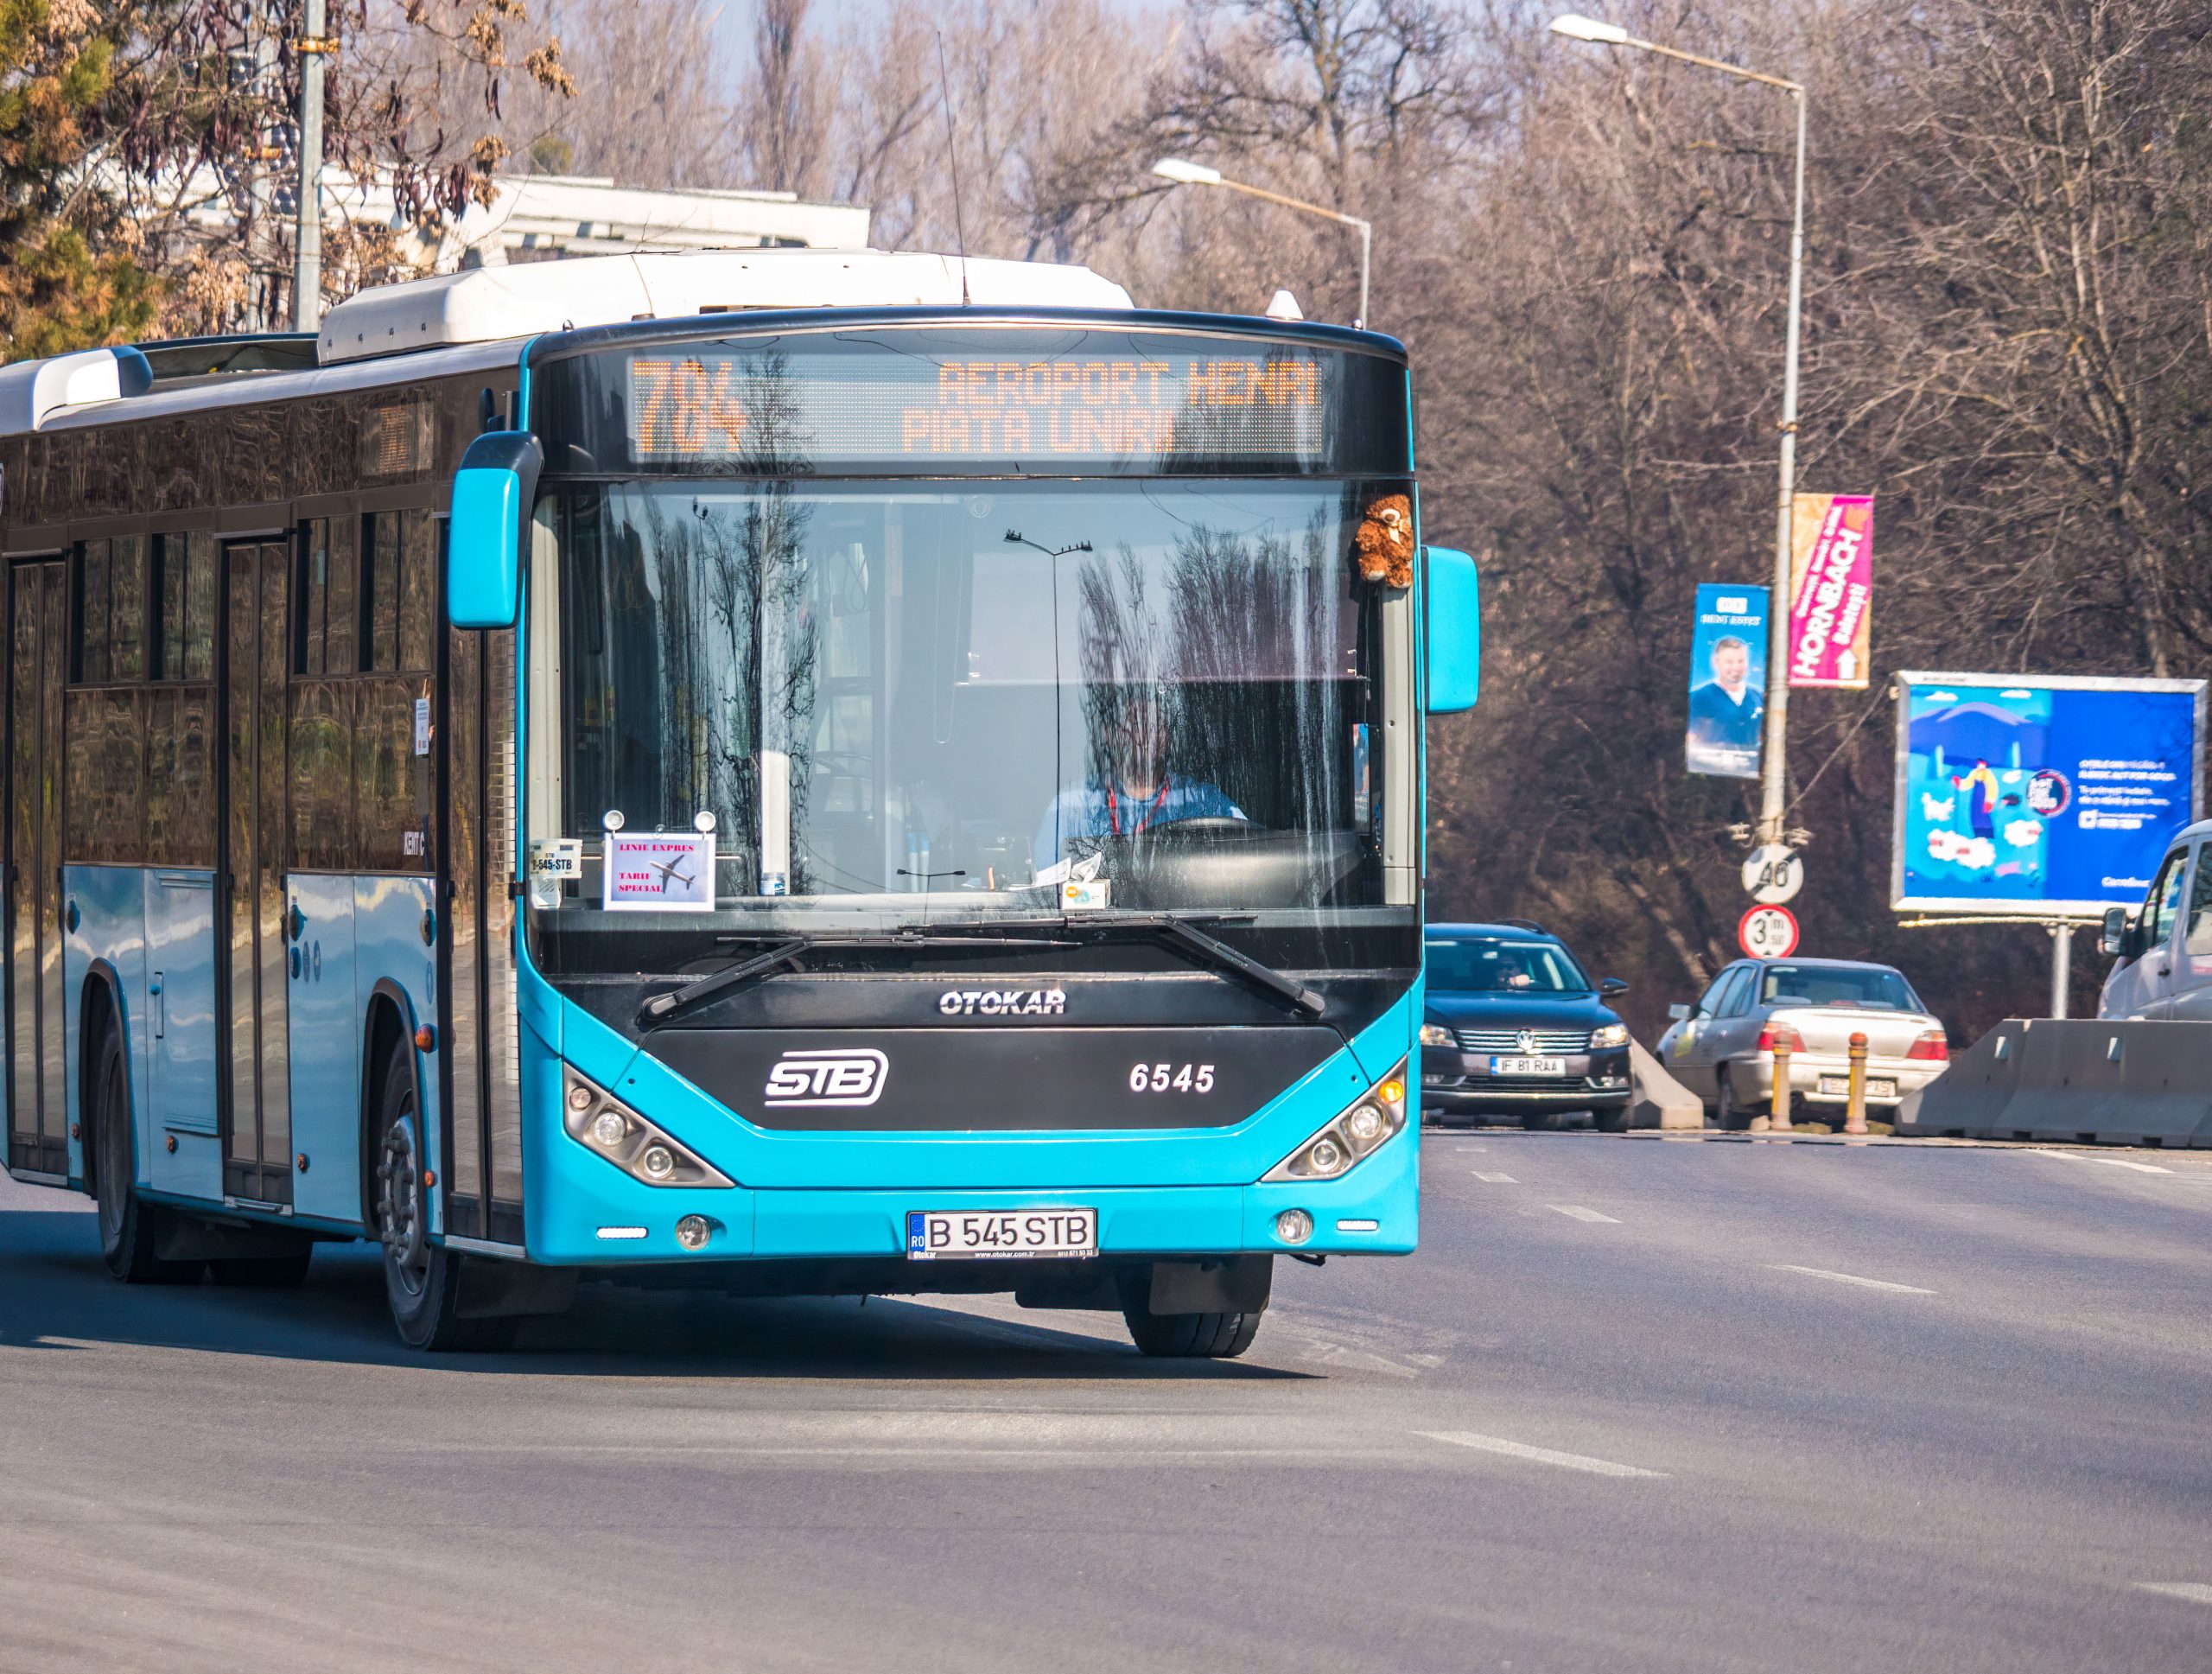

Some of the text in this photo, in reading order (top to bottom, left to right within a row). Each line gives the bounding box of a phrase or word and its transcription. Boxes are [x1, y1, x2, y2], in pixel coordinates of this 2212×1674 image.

[939, 361, 1316, 405] AEROPORT HENRI
[903, 408, 1173, 453] PIATA UNIRII
[1791, 527, 1864, 678] HORNBACH
[619, 843, 695, 853] LINIE EXPRES
[619, 871, 652, 881] TARIF
[1758, 861, 1789, 888] 40
[619, 884, 664, 893] SPECIAL
[1752, 918, 1767, 945] 3
[938, 990, 1068, 1015] OTOKAR
[765, 1059, 879, 1098] STB
[1128, 1063, 1217, 1094] 6545
[1502, 1060, 1513, 1072] IF
[911, 1215, 1089, 1248] RO B 545 STB
[913, 1251, 937, 1259] Otokar
